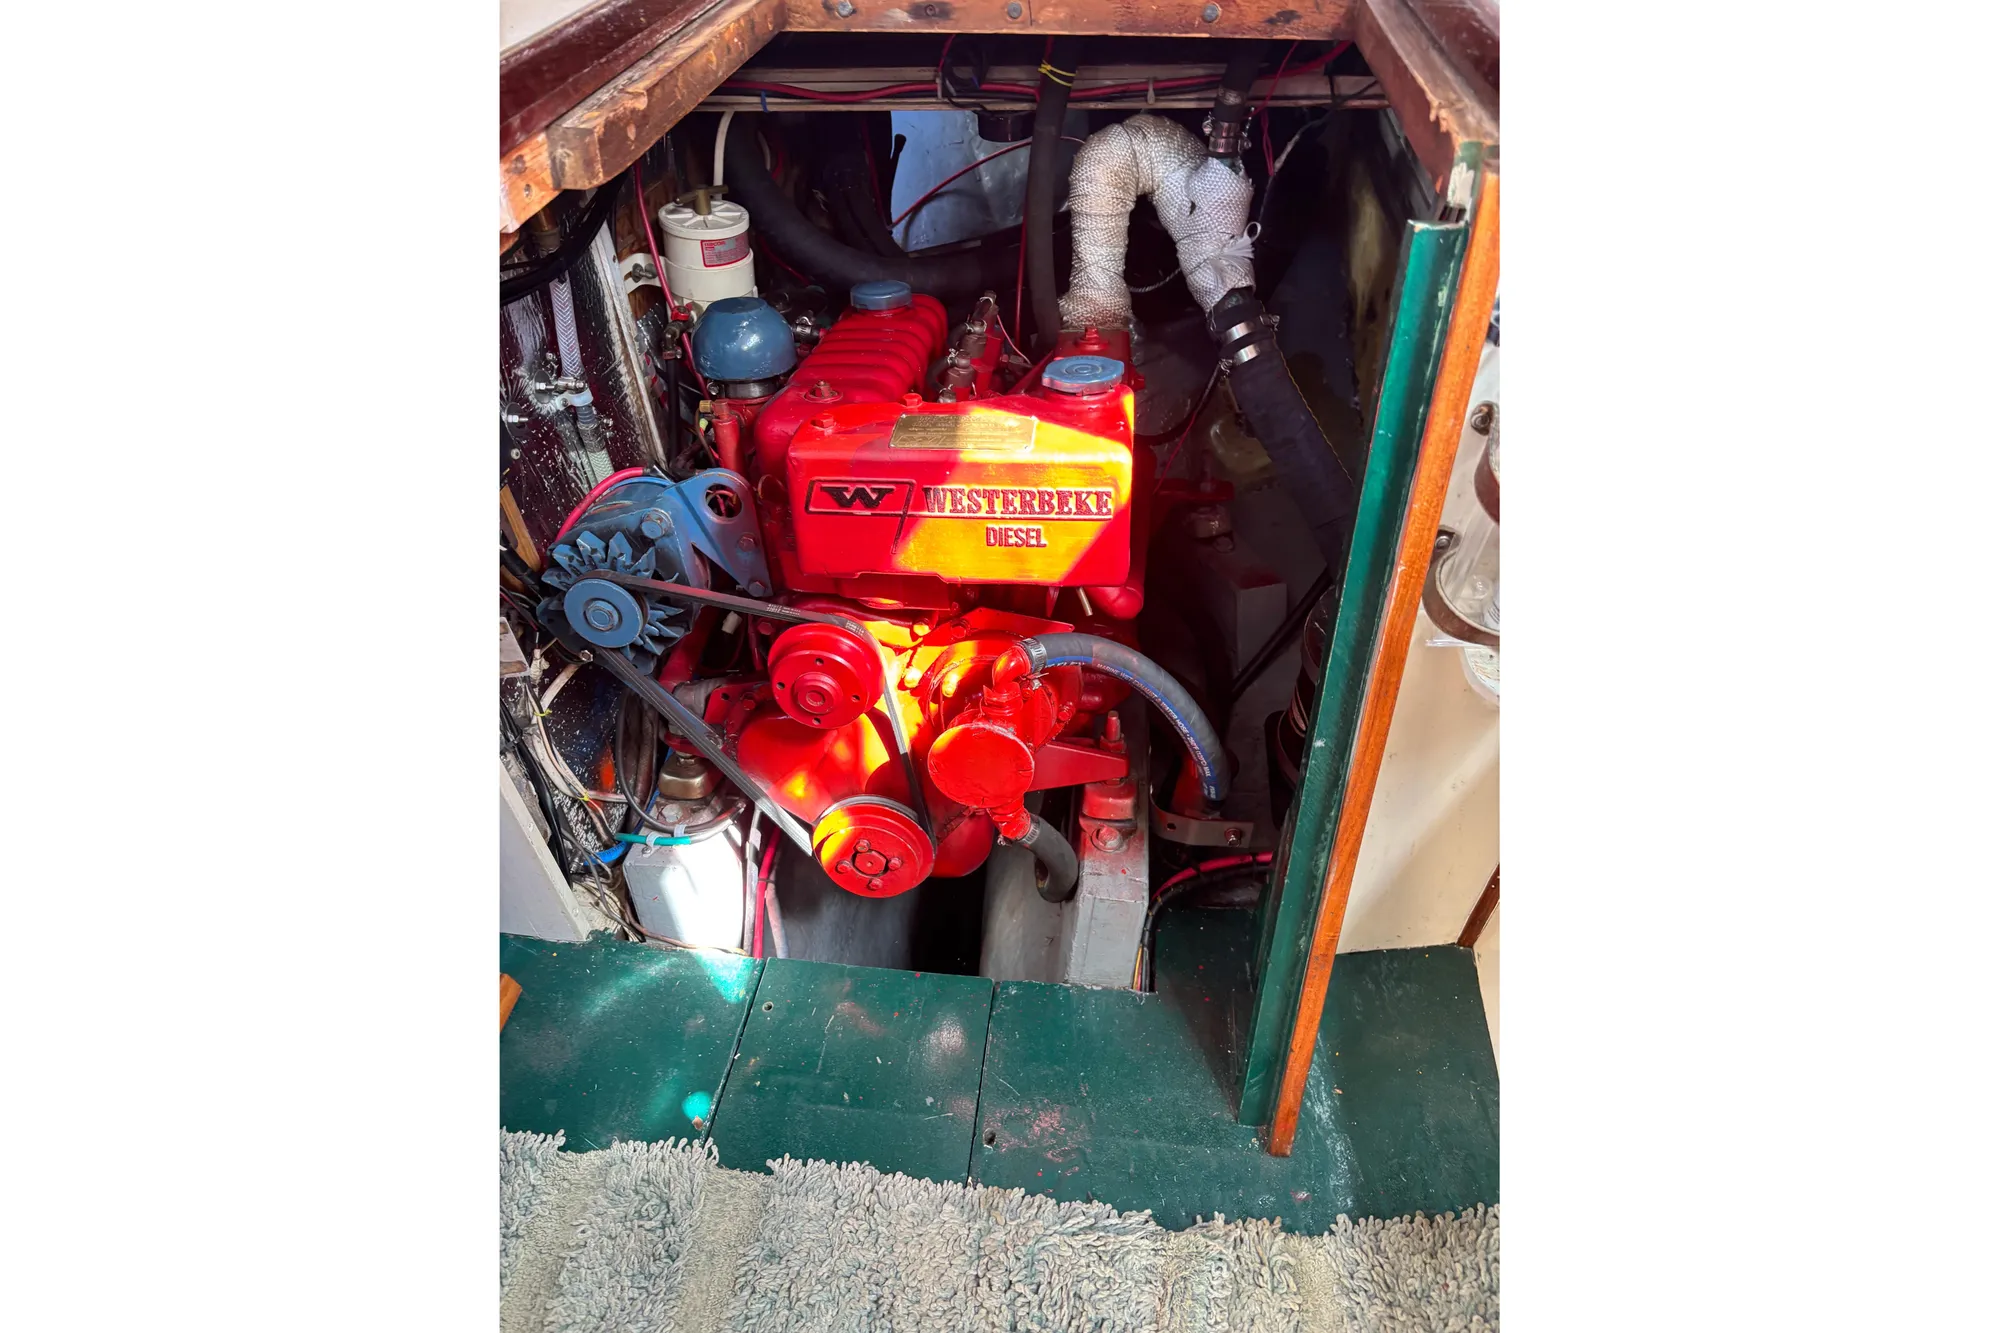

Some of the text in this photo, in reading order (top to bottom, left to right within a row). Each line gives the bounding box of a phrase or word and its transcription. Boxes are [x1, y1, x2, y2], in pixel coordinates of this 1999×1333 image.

[922, 486, 1113, 516] WESTERBEKE
[985, 526, 1047, 548] DIESEL
[1097, 663, 1120, 674] MARINE
[1160, 702, 1178, 719] WATER
[1175, 718, 1190, 734] HOSE
